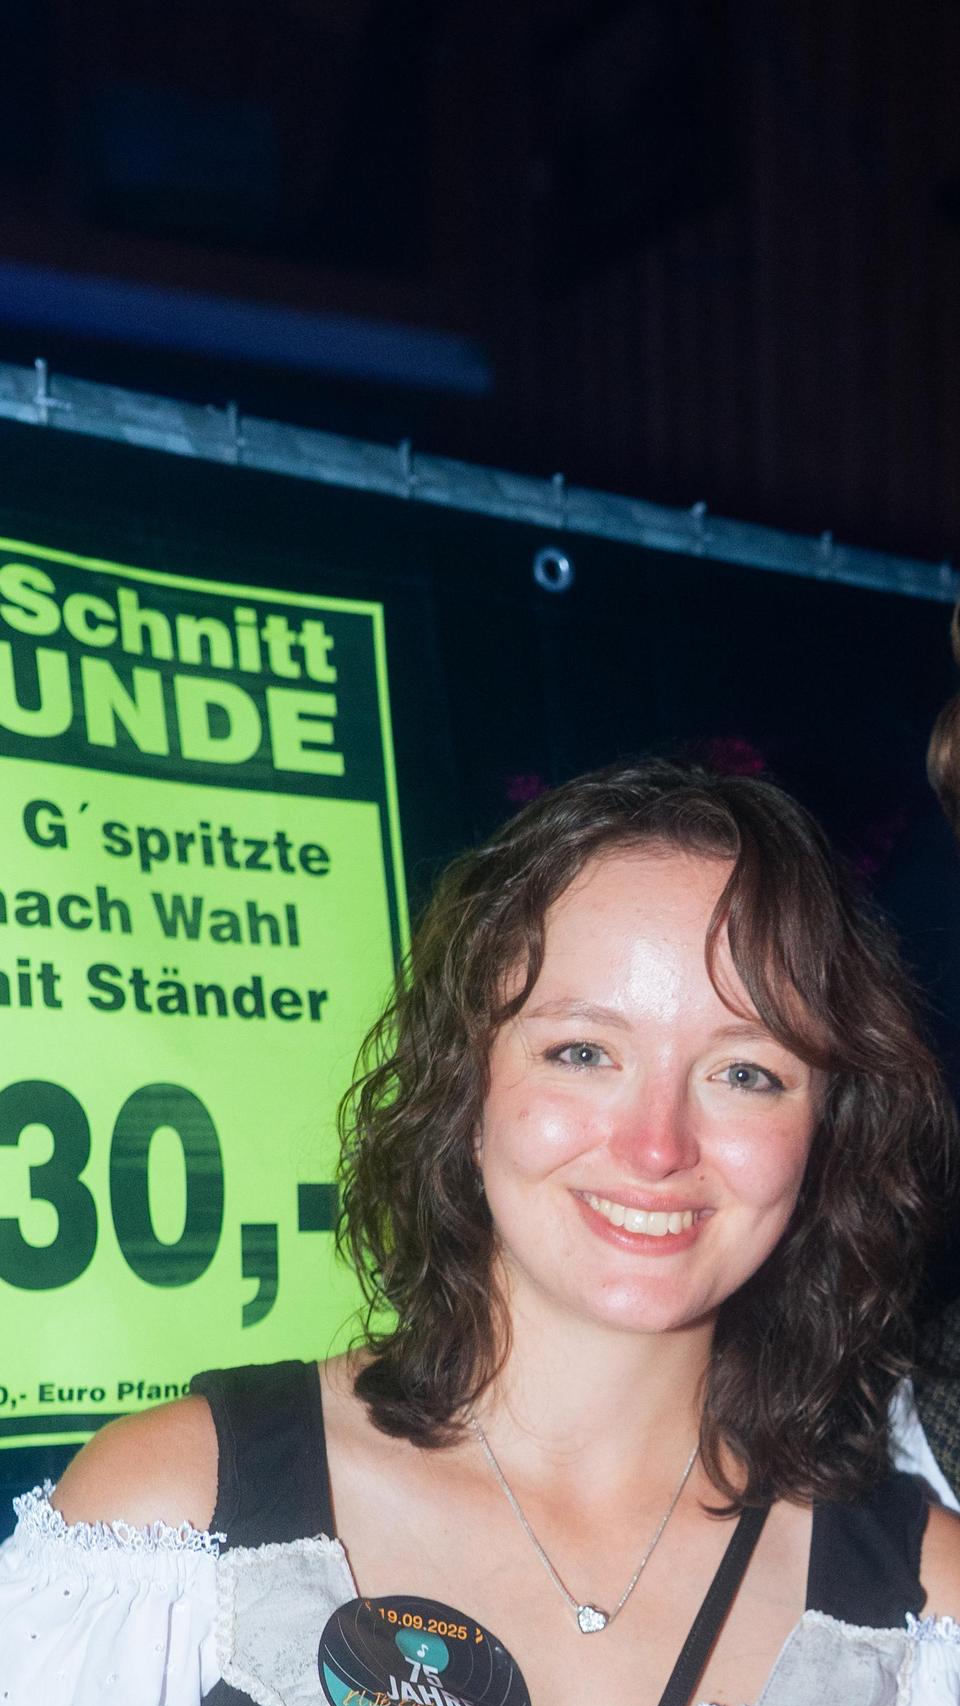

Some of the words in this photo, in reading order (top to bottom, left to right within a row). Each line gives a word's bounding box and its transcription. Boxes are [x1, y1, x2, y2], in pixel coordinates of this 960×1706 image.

[0, 562, 338, 683] Schnitt
[151, 891, 301, 946] Wahl
[86, 962, 328, 1022] Ständer
[39, 1383, 105, 1403] Euro
[378, 1608, 468, 1641] 19.09.2025
[405, 1656, 444, 1688] 75
